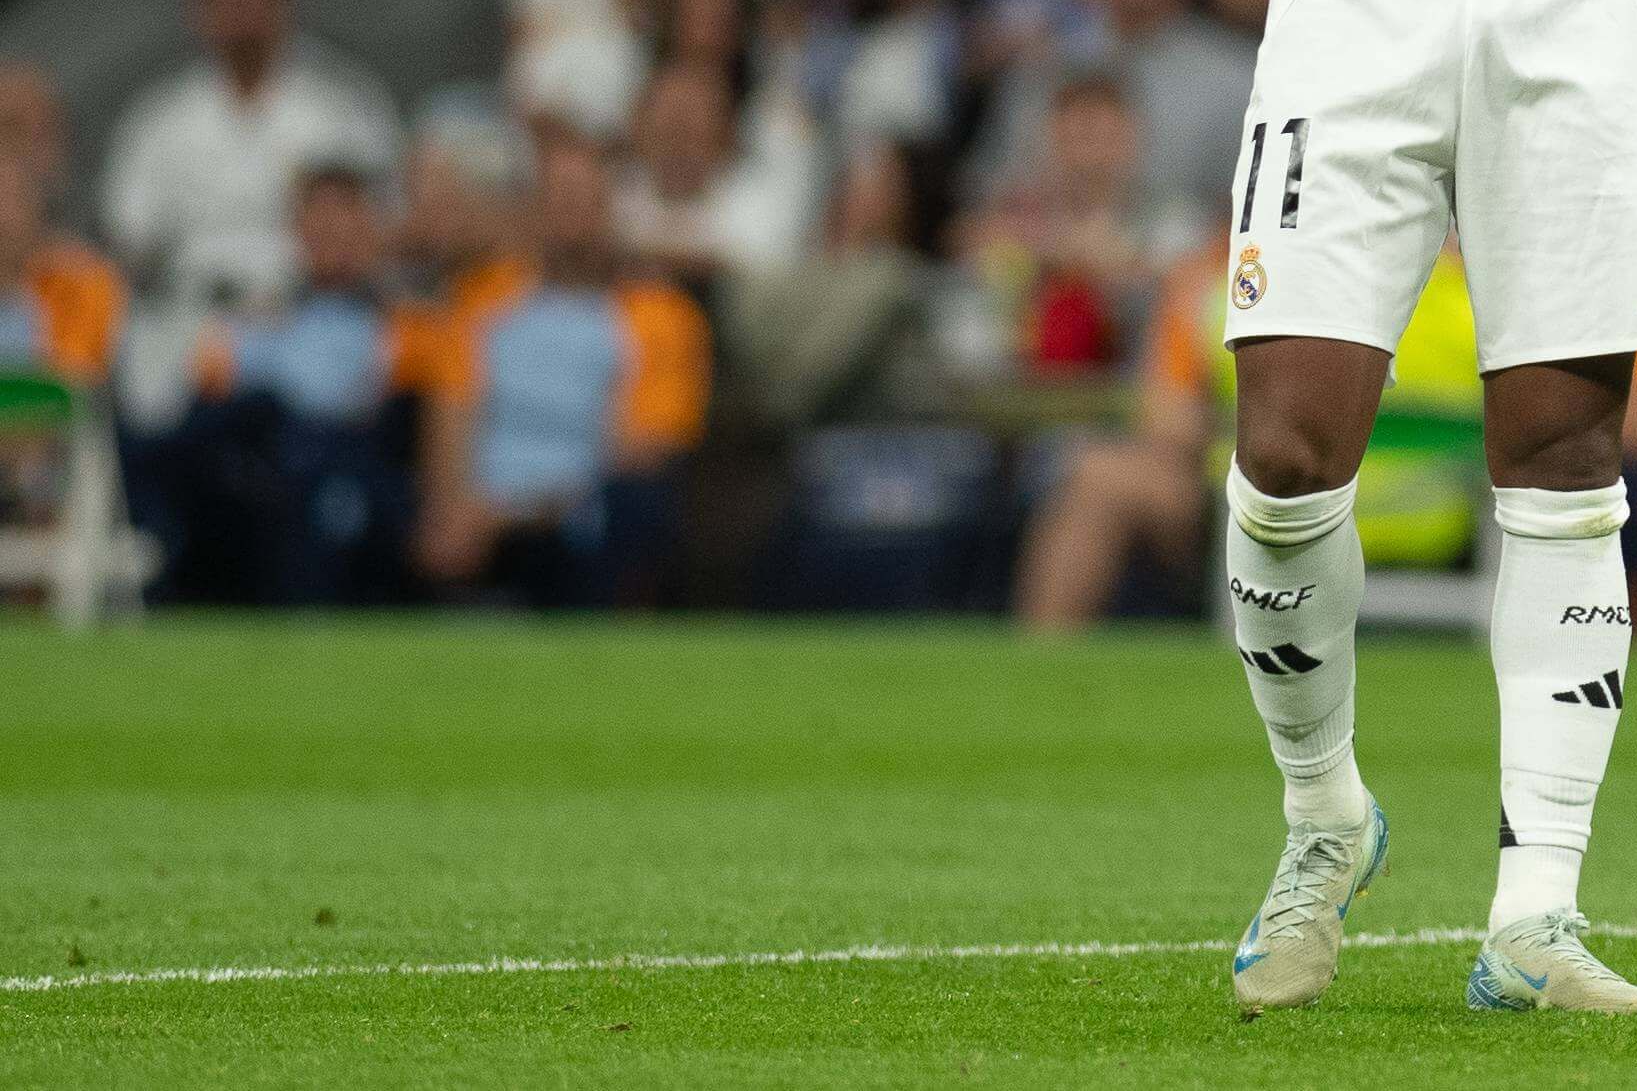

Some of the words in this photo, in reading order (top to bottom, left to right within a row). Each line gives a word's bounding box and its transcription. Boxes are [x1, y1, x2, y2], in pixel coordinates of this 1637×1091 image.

[1238, 117, 1312, 234] 11
[1230, 577, 1317, 611] RMCF
[1559, 605, 1633, 627] RMC
